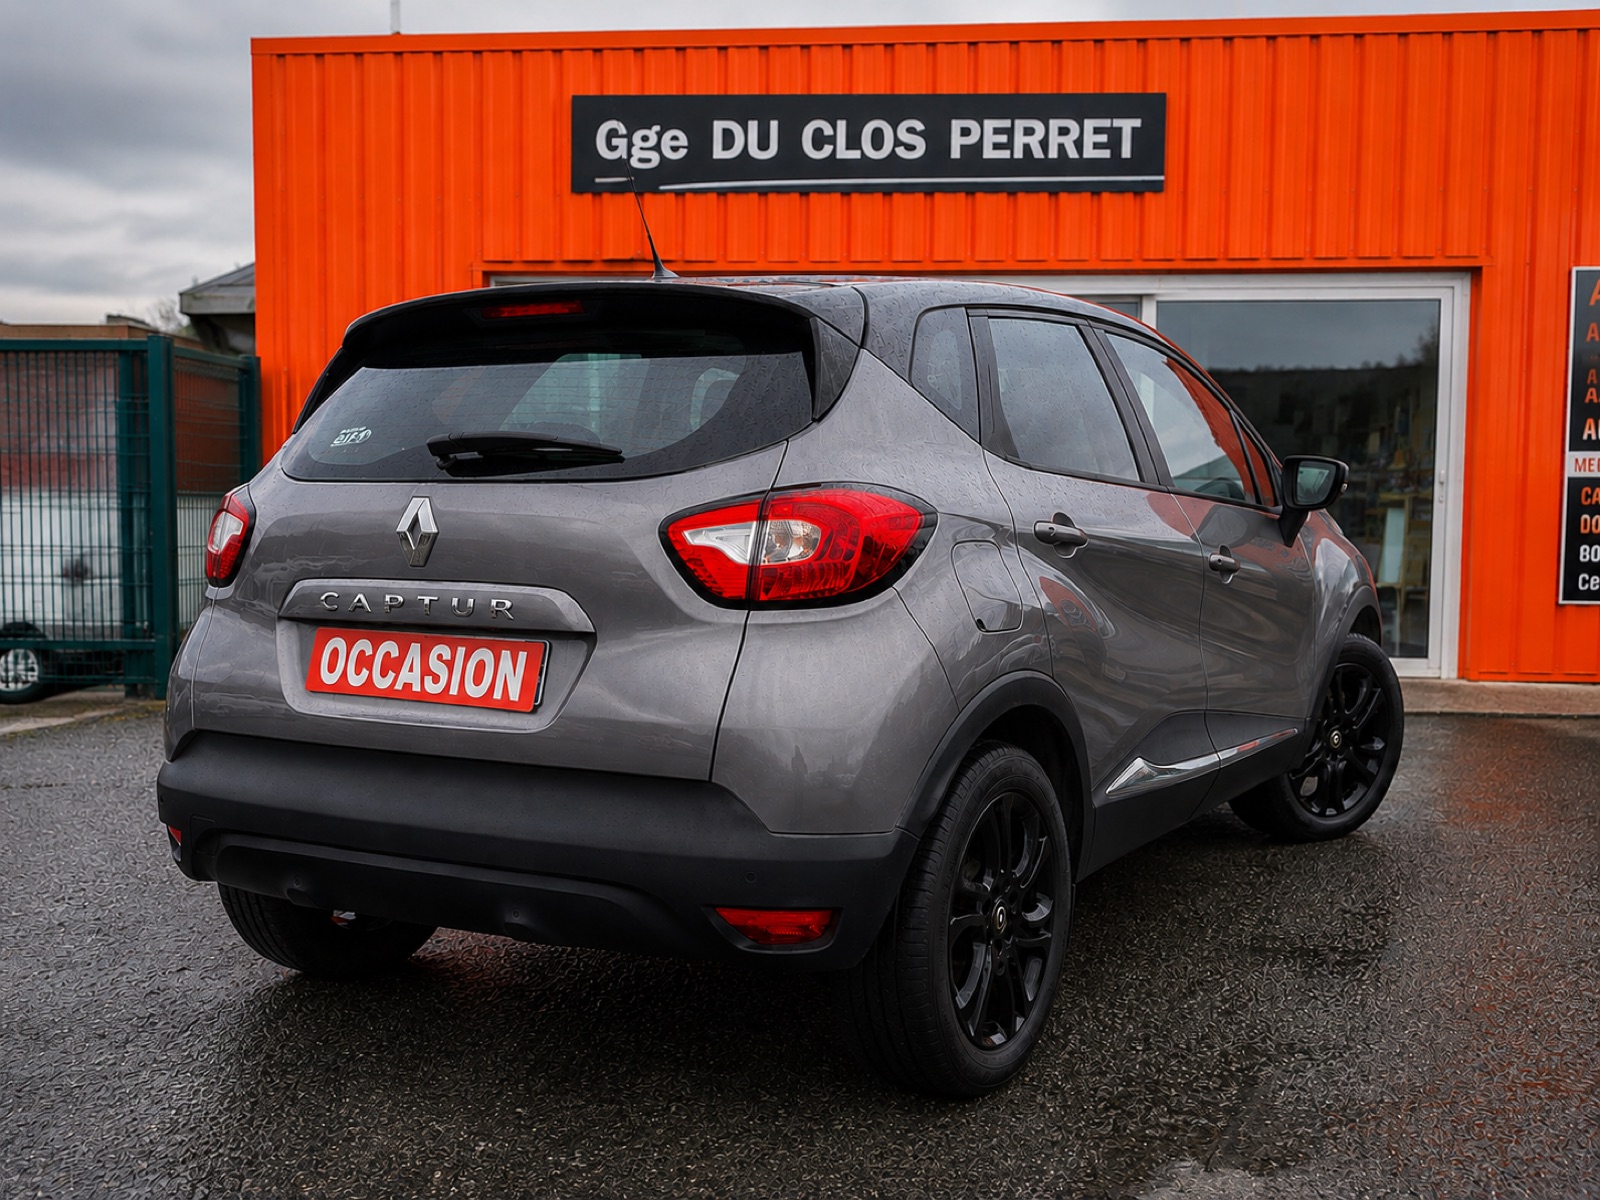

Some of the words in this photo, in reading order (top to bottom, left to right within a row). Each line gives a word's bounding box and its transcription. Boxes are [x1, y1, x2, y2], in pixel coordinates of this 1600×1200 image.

[595, 119, 689, 169] Gge
[712, 119, 780, 160] DU
[801, 118, 928, 160] CLOS
[950, 117, 1142, 160] PERRET
[1574, 457, 1600, 473] ME
[319, 591, 515, 621] CAPTUR
[319, 637, 528, 702] OCCASION
